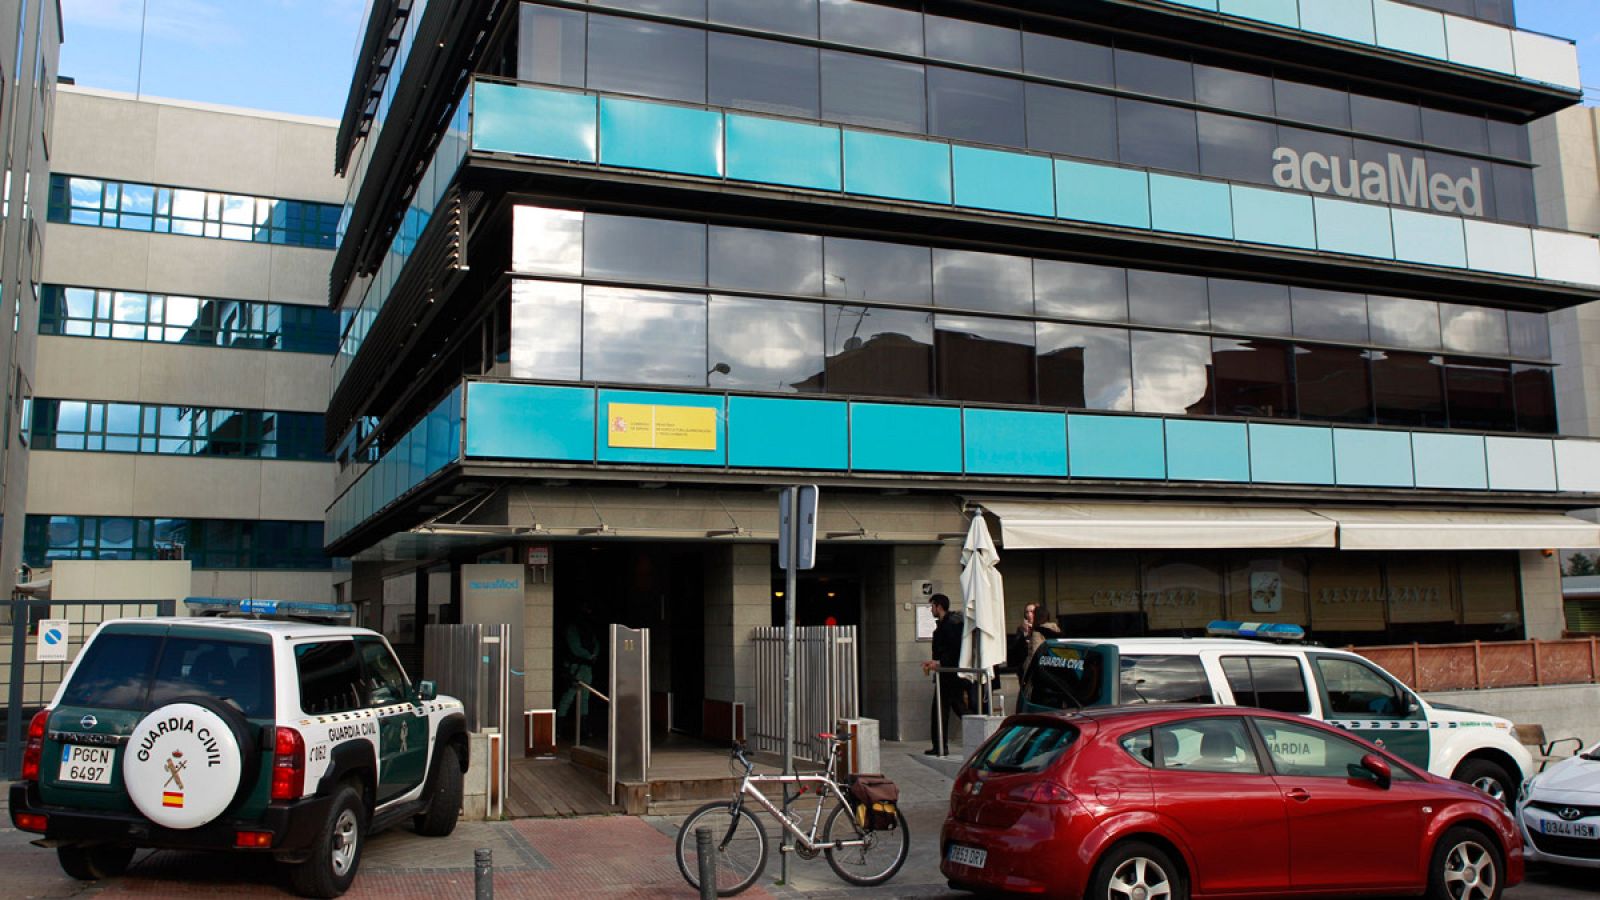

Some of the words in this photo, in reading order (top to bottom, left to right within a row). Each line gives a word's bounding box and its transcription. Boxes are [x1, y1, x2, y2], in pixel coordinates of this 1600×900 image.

[1272, 147, 1484, 216] acuaMed
[328, 723, 361, 742] GUARDIA
[361, 722, 376, 736] CIVIL
[137, 717, 194, 762] GUARDIA
[197, 728, 221, 767] CIVIL
[1269, 742, 1311, 755] ARDIA
[73, 748, 109, 764] PGCN
[70, 766, 104, 781] 6497
[1546, 822, 1571, 835] 0344
